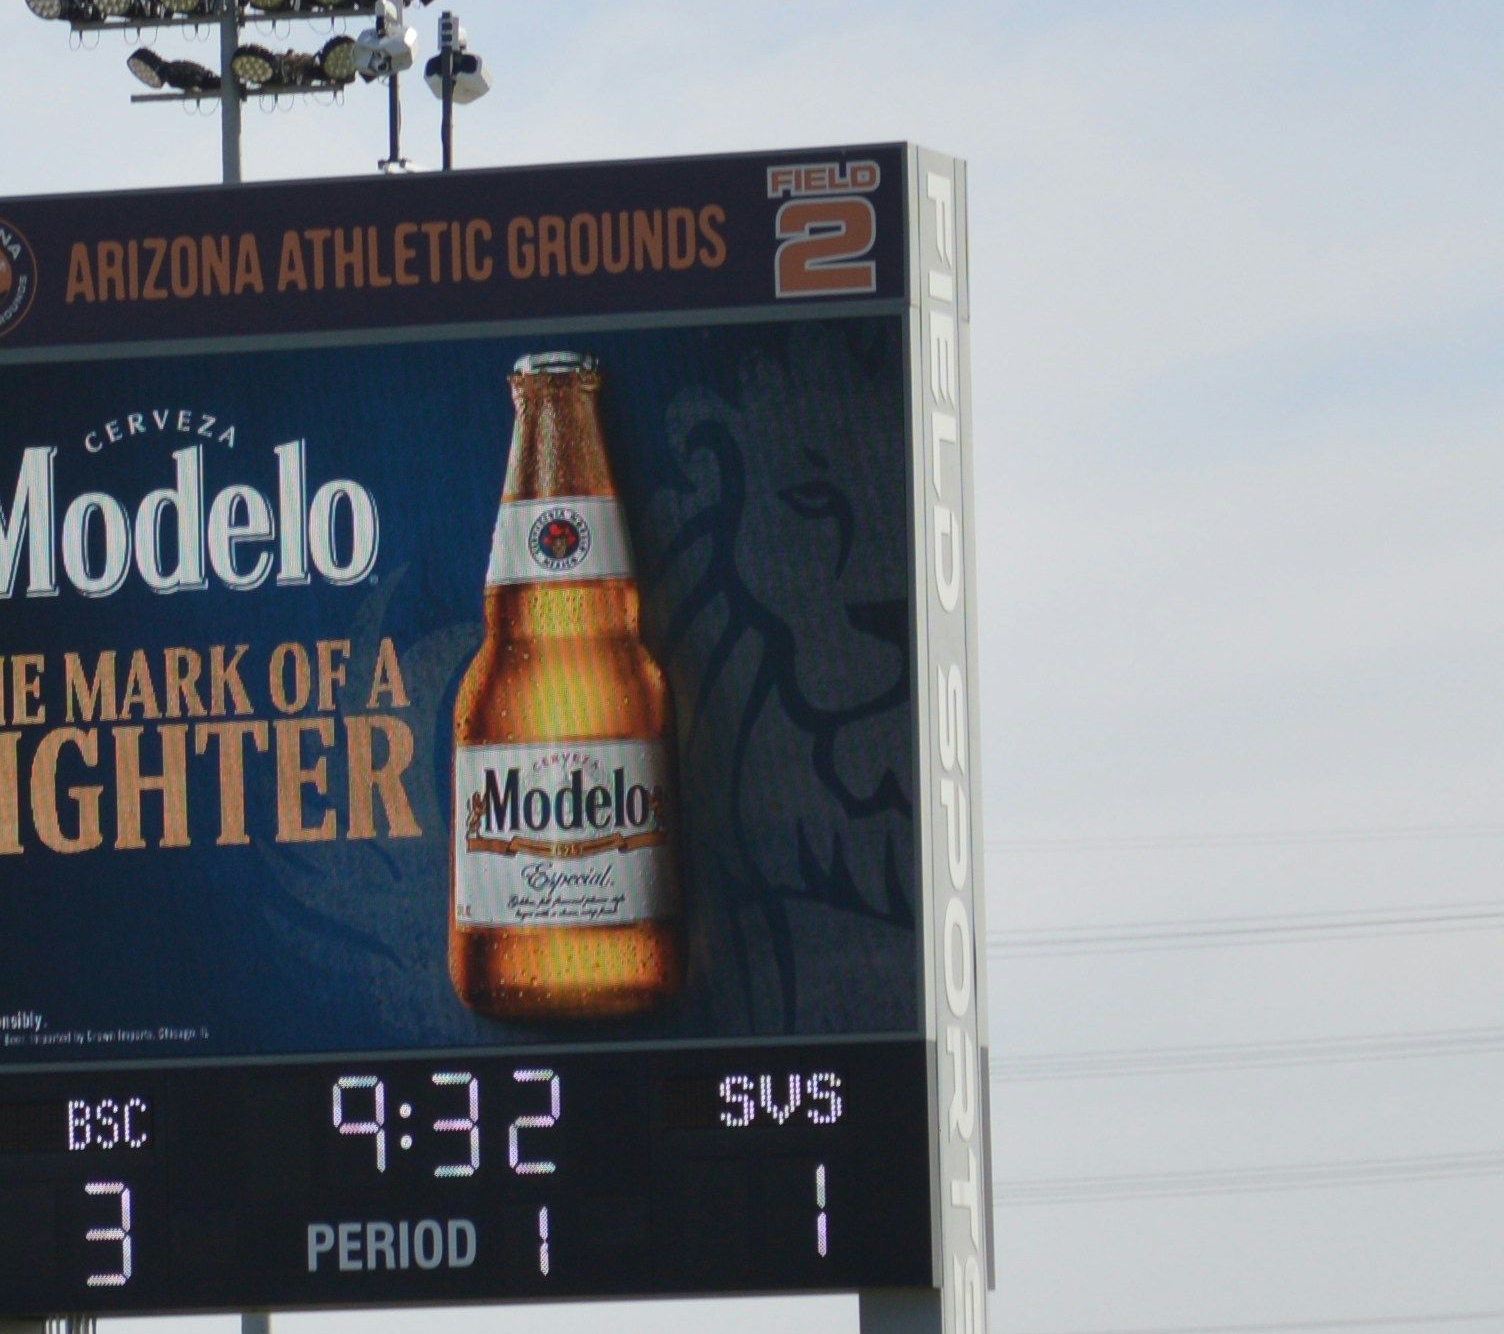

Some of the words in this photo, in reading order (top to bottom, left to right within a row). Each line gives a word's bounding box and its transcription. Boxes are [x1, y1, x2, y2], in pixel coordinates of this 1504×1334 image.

[767, 160, 881, 199] FIELD
[65, 233, 264, 304] ARIZONA
[277, 218, 493, 293] ATHLETIC
[507, 203, 728, 280] GROUNDS
[775, 195, 877, 299] 2
[84, 408, 237, 453] CERVEZA
[926, 170, 961, 614] FIELD
[64, 643, 255, 723] MARK
[269, 638, 351, 714] OF
[367, 636, 411, 708] A
[484, 767, 651, 832] Modelo
[68, 1096, 147, 1151] BSC
[332, 1069, 561, 1178] 9:32
[718, 1072, 843, 1127] SVS
[84, 1181, 132, 1287] 3
[307, 1218, 478, 1273] PERIOD
[538, 1204, 550, 1278] 1
[815, 1163, 828, 1259] 1
